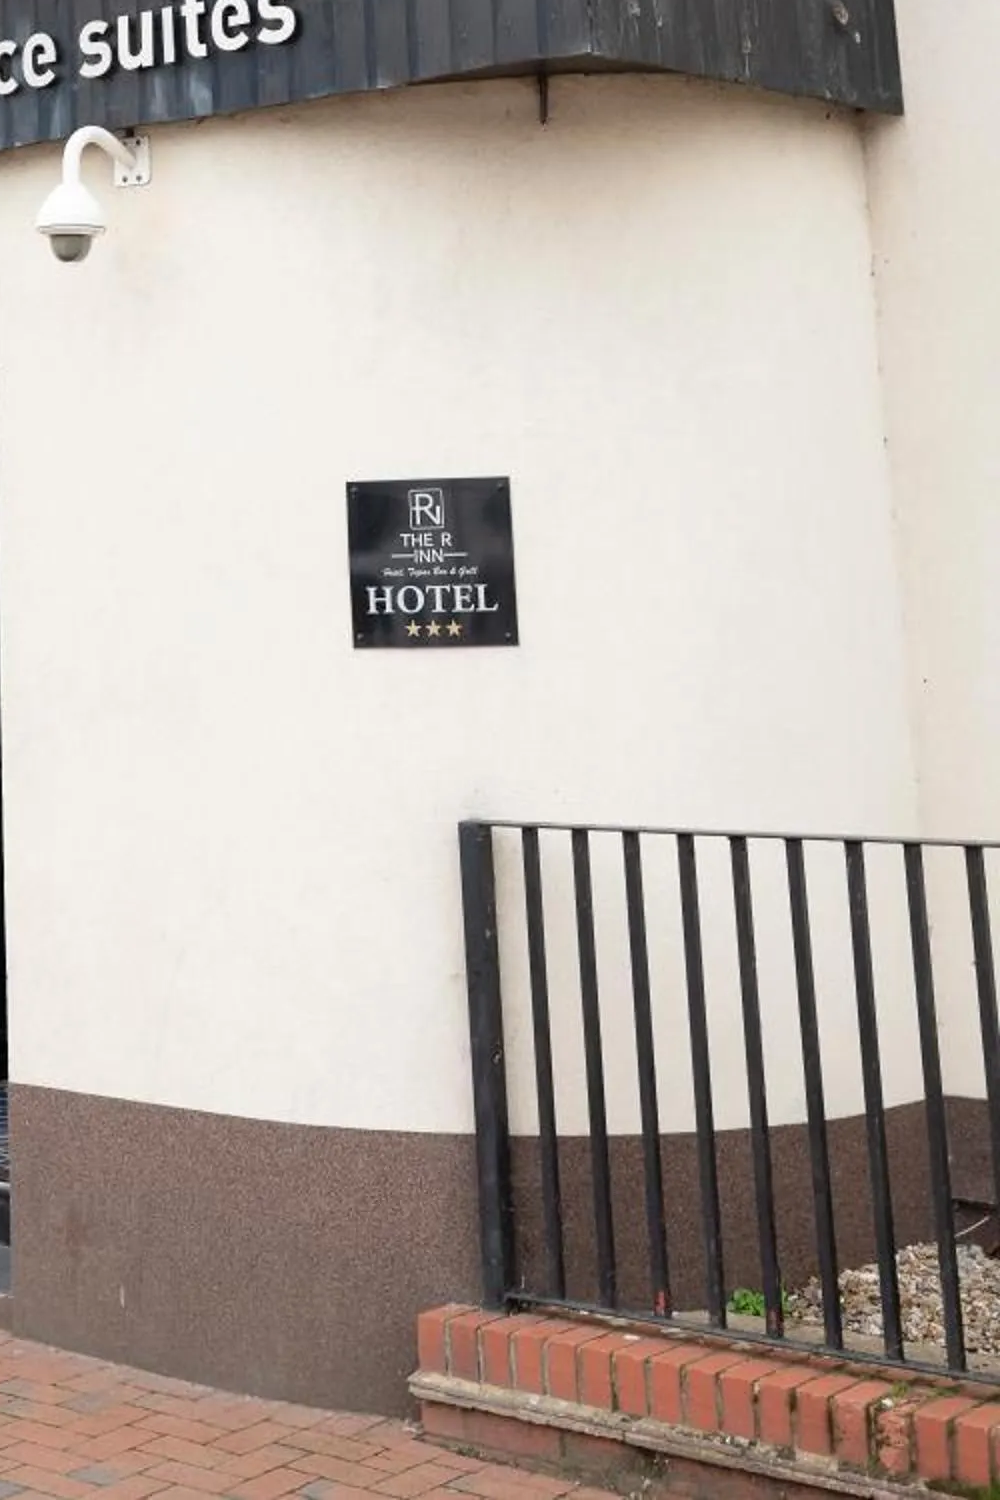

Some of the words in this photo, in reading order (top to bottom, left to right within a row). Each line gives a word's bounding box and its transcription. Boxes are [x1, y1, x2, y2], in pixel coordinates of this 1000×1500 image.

[399, 532, 435, 548] THE
[441, 532, 453, 547] R
[413, 548, 444, 563] INN
[366, 583, 499, 614] HOTEL
